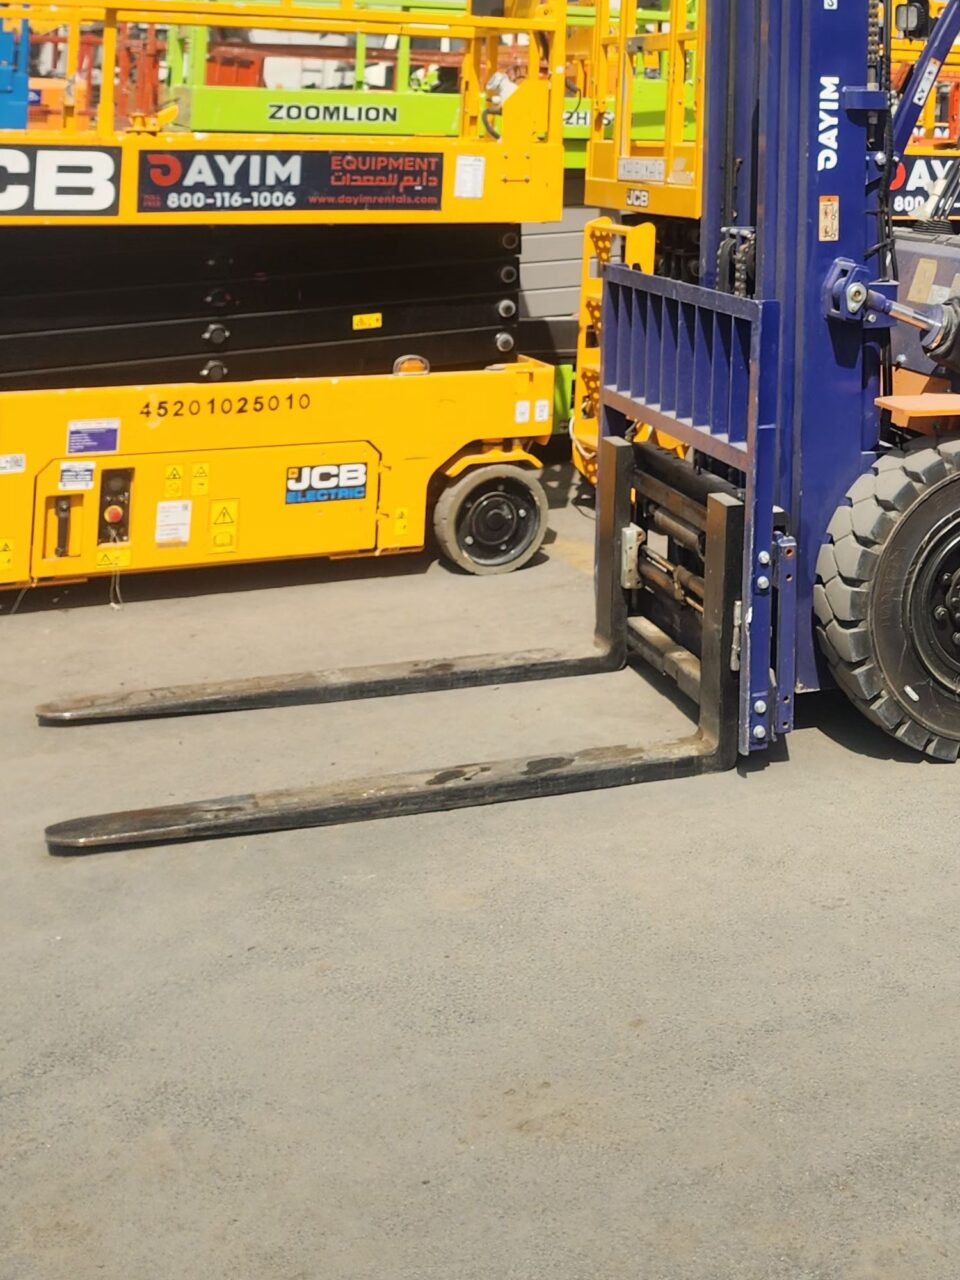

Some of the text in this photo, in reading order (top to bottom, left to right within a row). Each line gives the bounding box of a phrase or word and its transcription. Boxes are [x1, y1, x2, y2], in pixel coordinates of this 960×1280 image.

[268, 104, 398, 122] ZOOMLION
[817, 76, 840, 171] DAYIM
[147, 153, 302, 187] DAYIM
[329, 156, 438, 171] EQUIPMENT
[330, 171, 398, 187] للمعدات
[399, 173, 438, 192] دايم
[166, 191, 296, 209] 800-116-1006
[308, 193, 438, 206] www.dayimrentals.com
[626, 188, 649, 207] JCB
[140, 393, 311, 418] 45201025010
[286, 463, 367, 491] JCB
[286, 486, 366, 504] ELECTRIC
